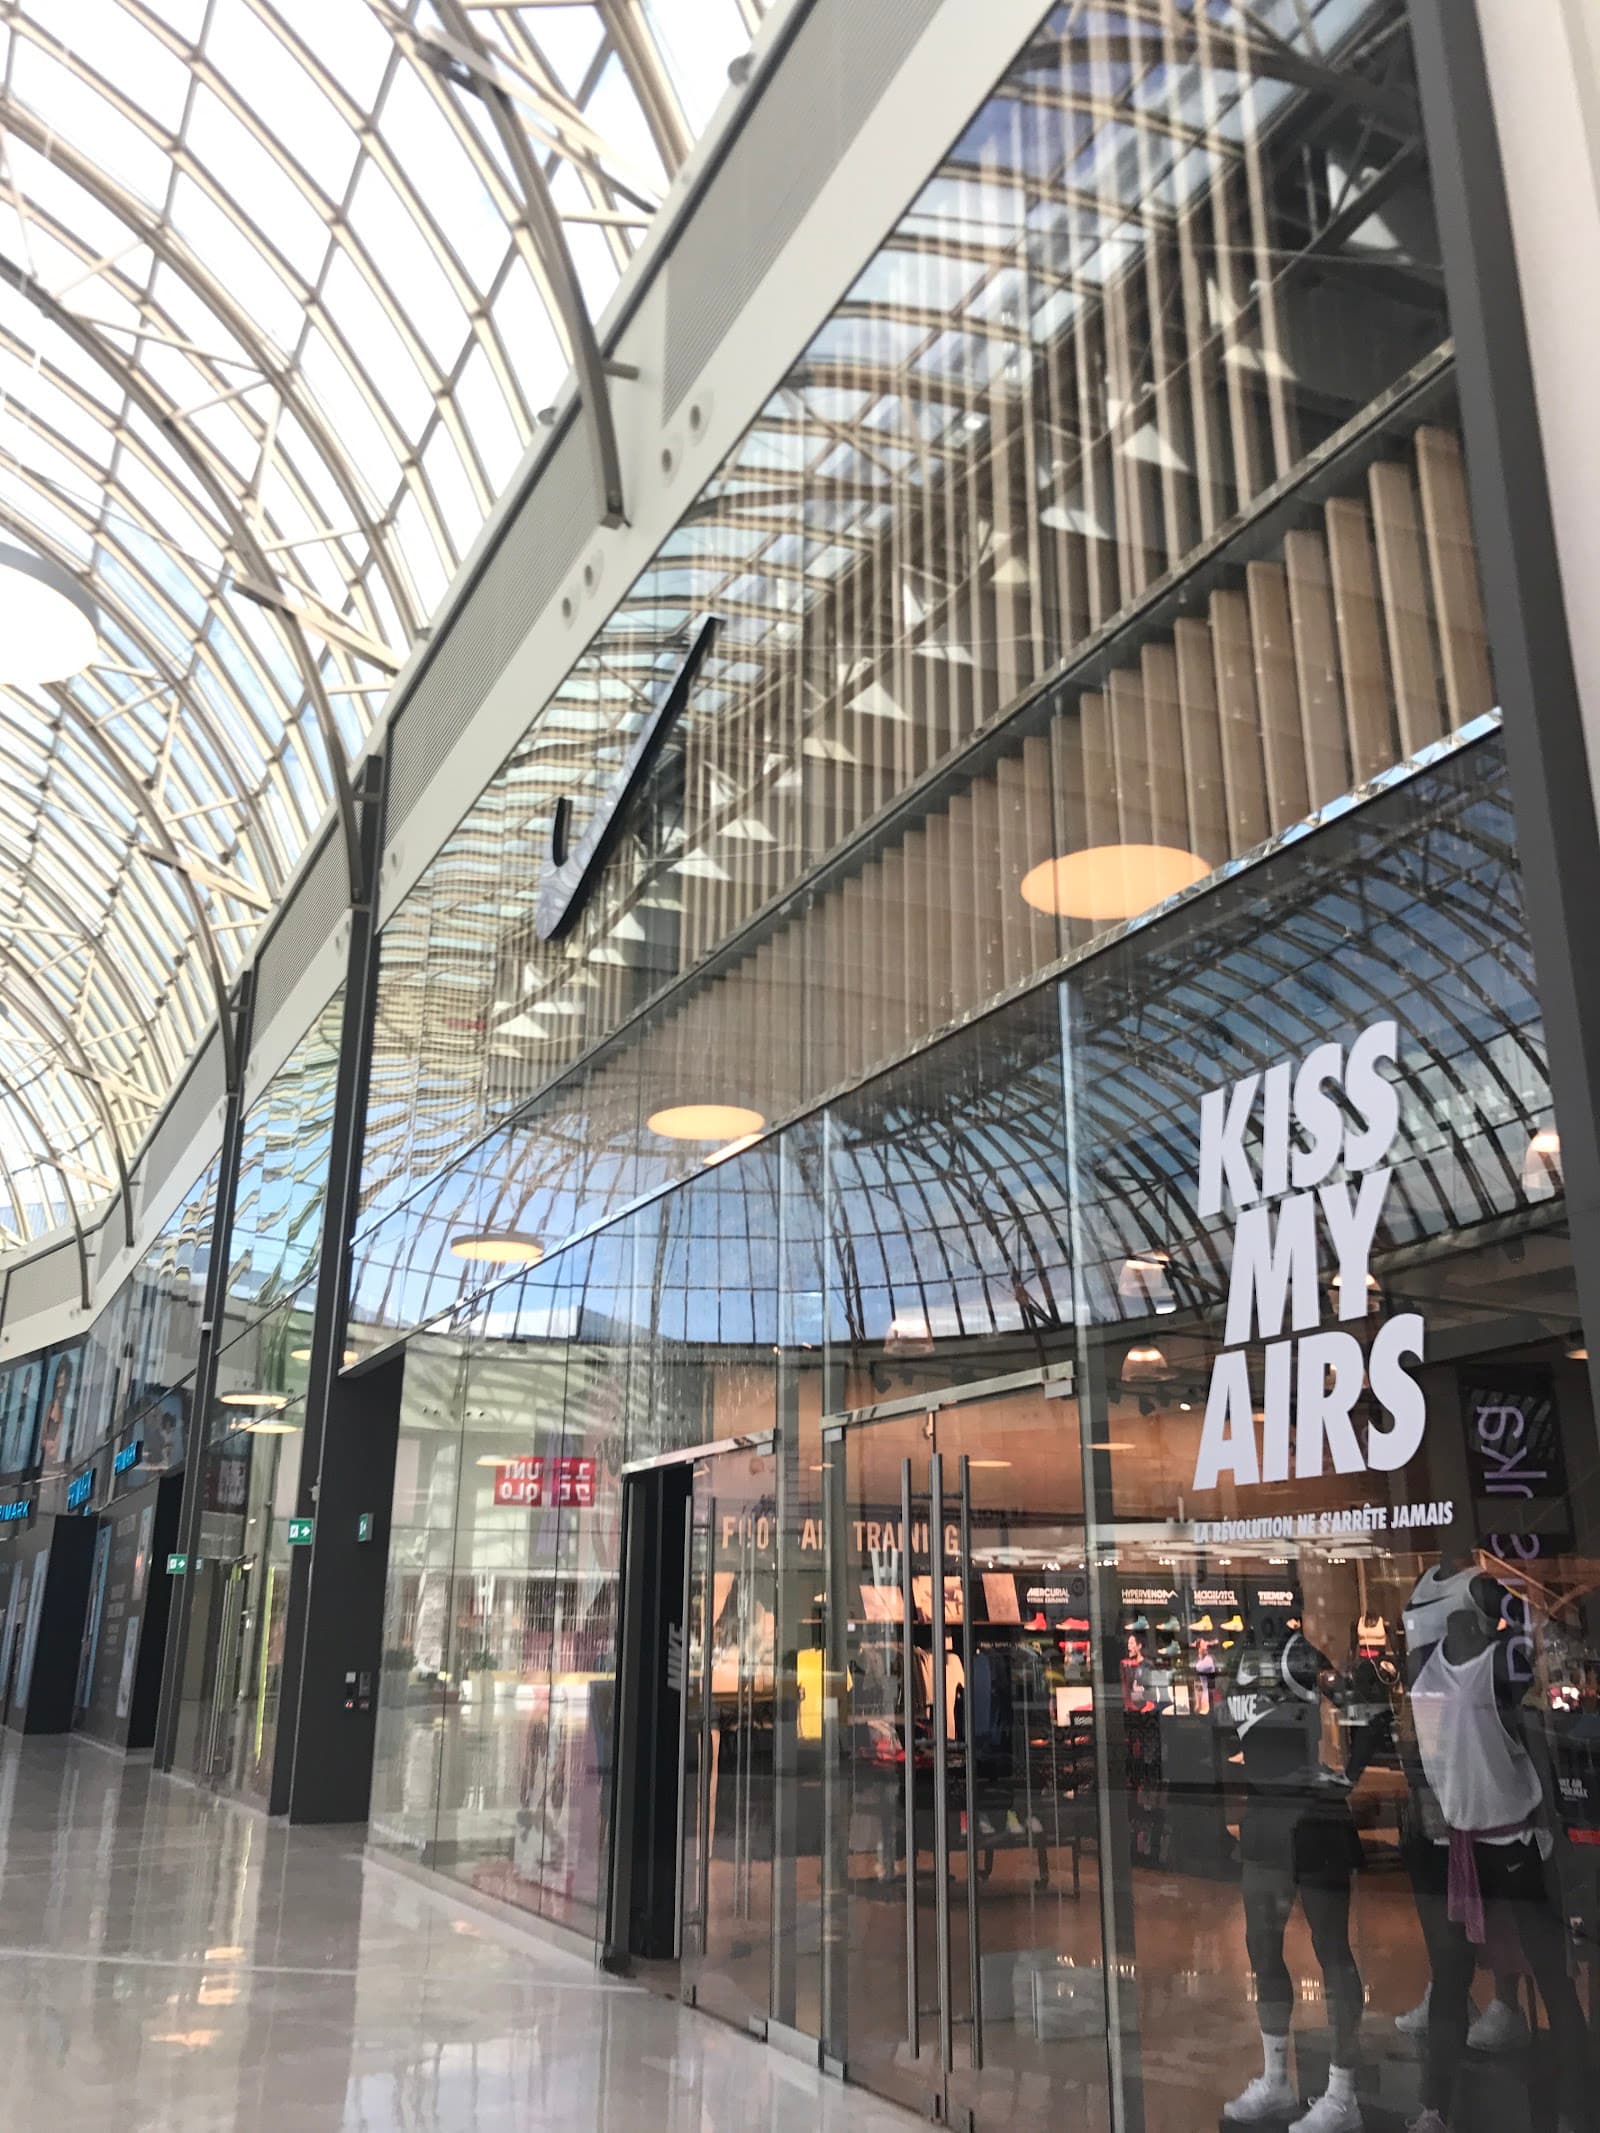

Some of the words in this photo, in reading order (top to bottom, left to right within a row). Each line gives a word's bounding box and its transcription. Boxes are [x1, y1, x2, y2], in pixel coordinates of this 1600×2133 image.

[1198, 1020, 1399, 1219] KISS
[1223, 1167, 1393, 1347] MY
[1192, 1313, 1427, 1490] AIRS
[853, 1521, 962, 1554] TRAINIG
[1193, 1521, 1209, 1544] LA
[1212, 1516, 1293, 1543] RÉVOLUTION
[1297, 1513, 1316, 1536] NE
[1319, 1503, 1387, 1535] S'ARRÊTE
[1390, 1501, 1454, 1529] JAMAIS
[1027, 1587, 1070, 1598] MERCURIAL
[1122, 1589, 1179, 1599] HYPERVENOM
[1257, 1591, 1293, 1600] TIEMPO
[1227, 1694, 1257, 1722] NIKE
